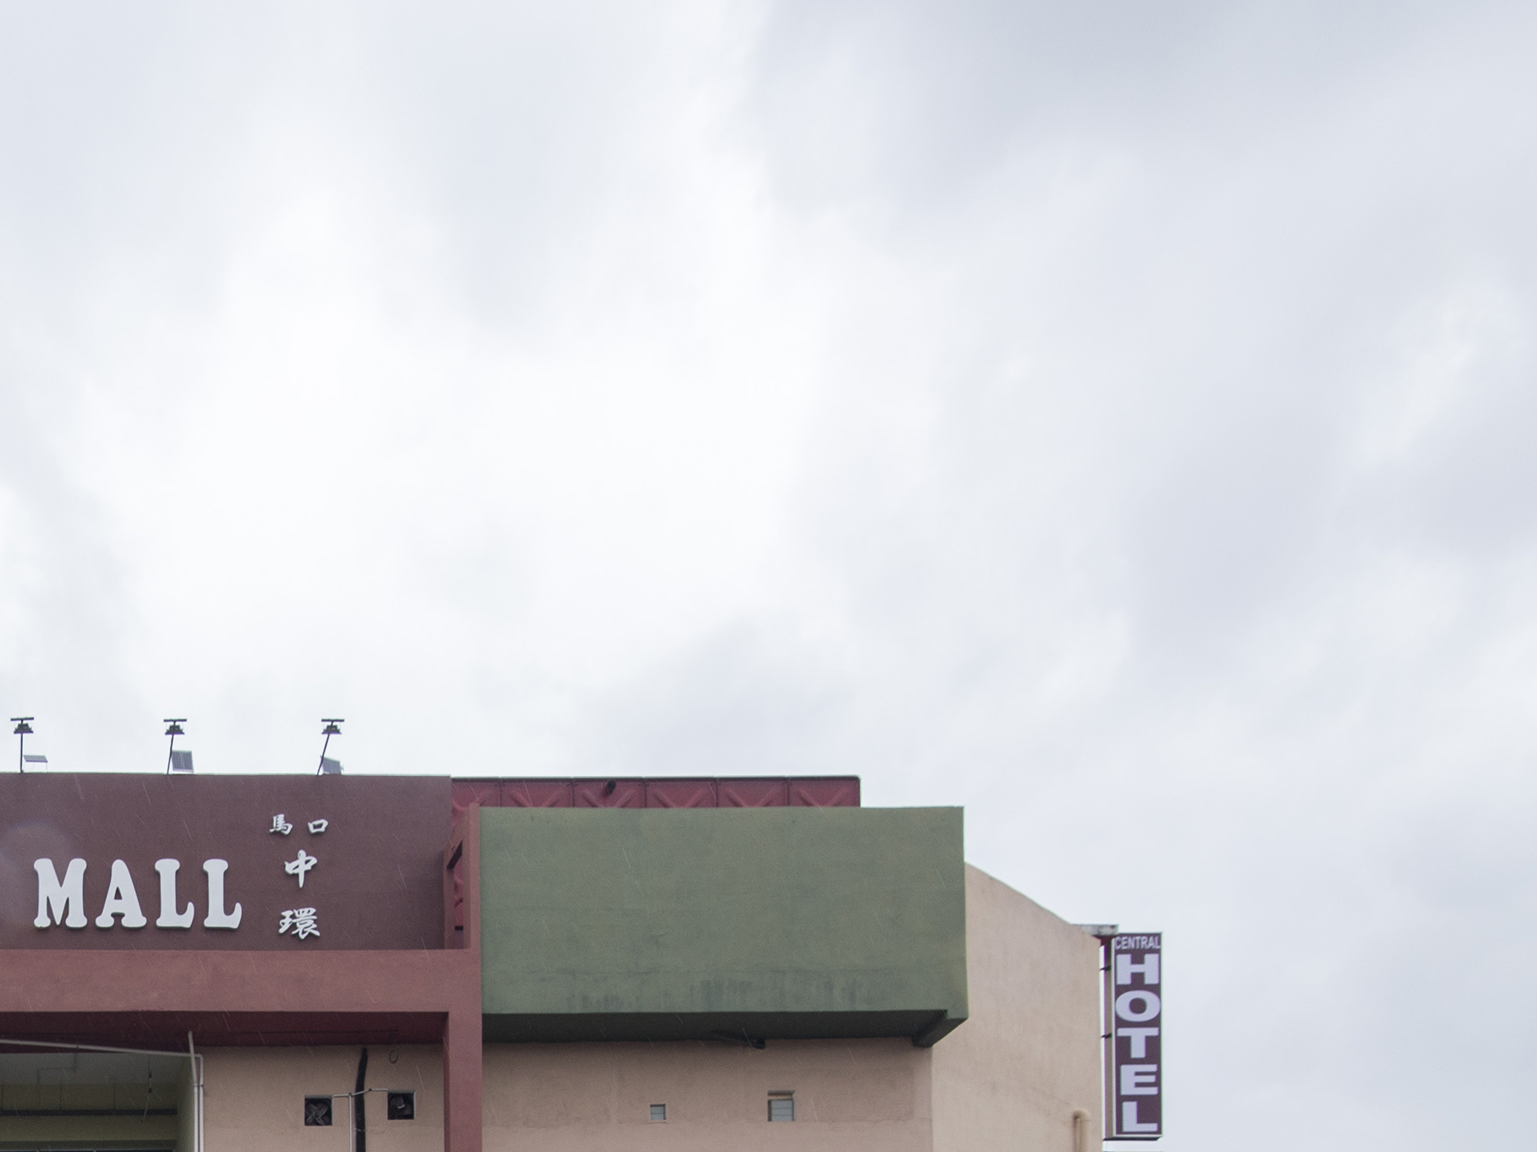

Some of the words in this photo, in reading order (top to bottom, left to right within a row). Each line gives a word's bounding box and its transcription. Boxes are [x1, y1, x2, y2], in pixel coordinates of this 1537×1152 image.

[33, 857, 243, 929] MALL
[1115, 936, 1161, 950] CENTRAL
[1115, 953, 1161, 1132] HOTEL
